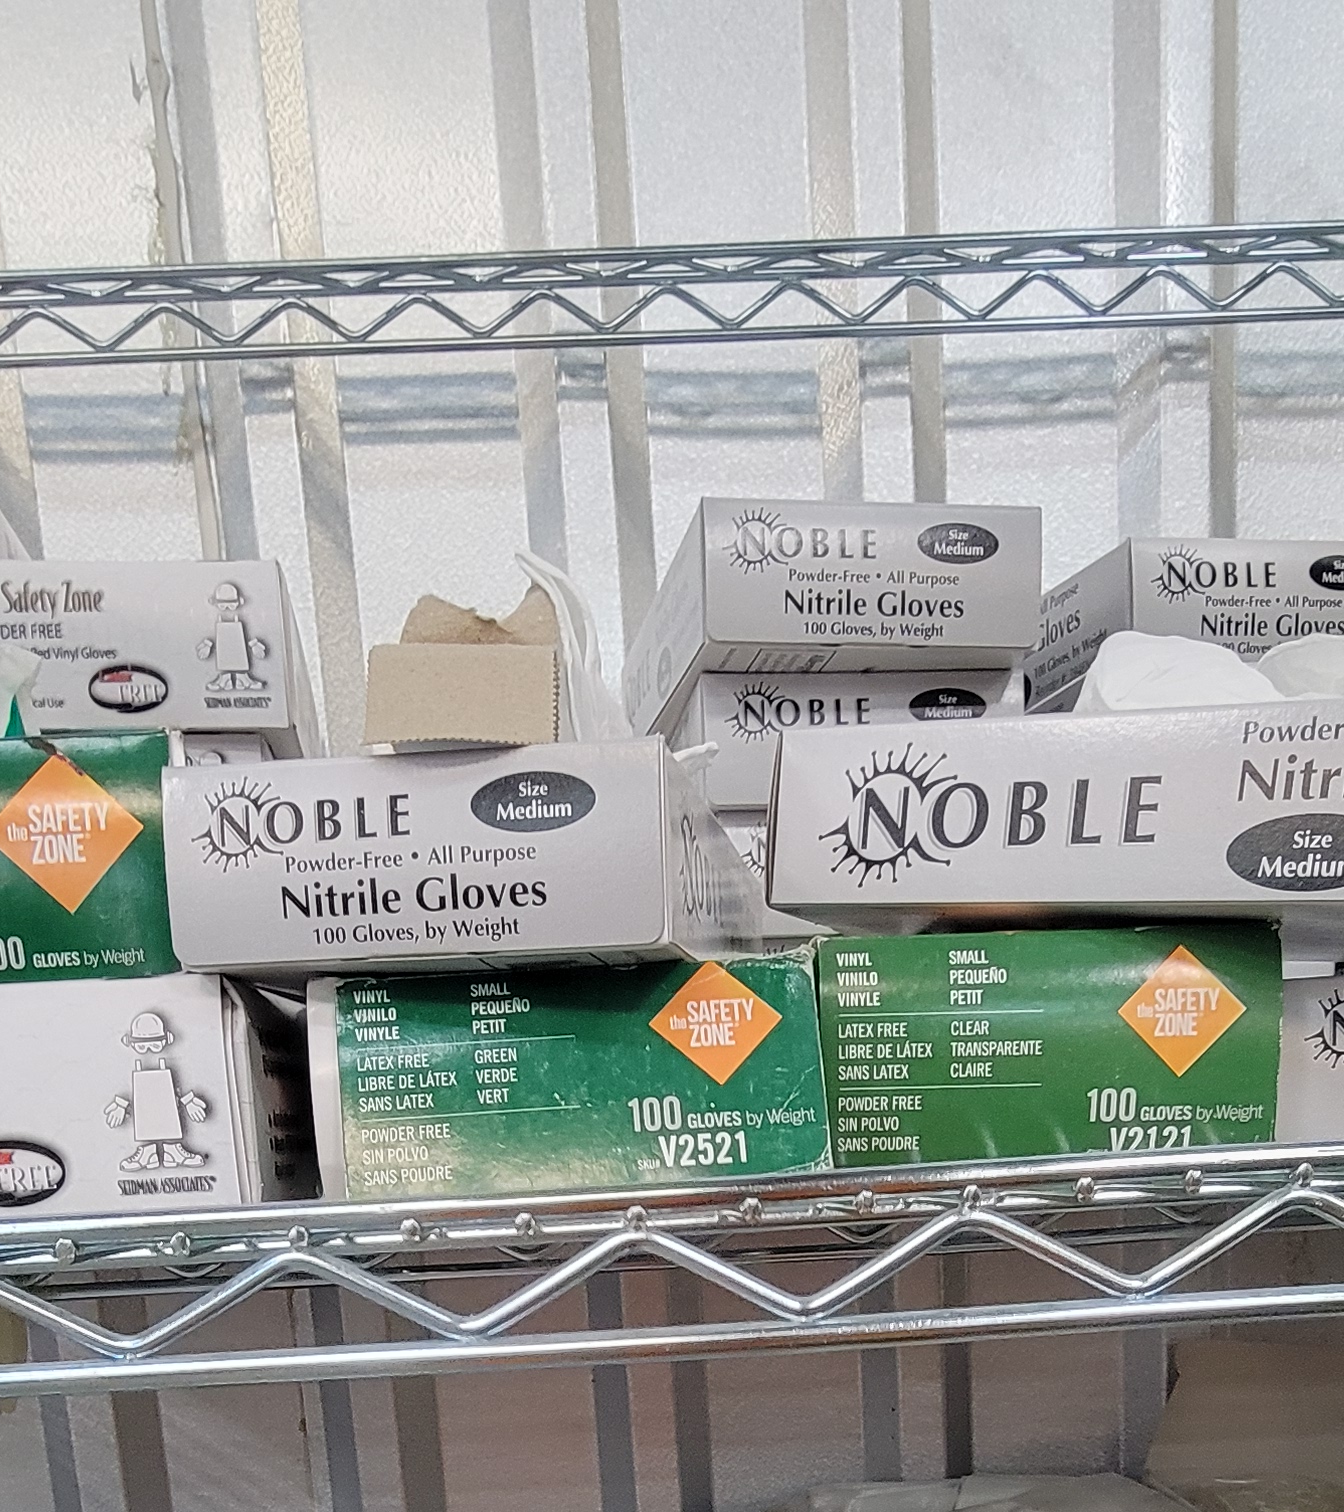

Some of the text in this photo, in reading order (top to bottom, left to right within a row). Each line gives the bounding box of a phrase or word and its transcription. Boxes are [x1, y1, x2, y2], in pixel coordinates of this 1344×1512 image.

[737, 528, 877, 566] NOBLE
[2, 579, 55, 618] Safety
[60, 580, 104, 613] Zone
[784, 590, 964, 620] Nitrile Gloves
[518, 781, 548, 797] Size
[496, 800, 572, 820] Medium
[855, 776, 1162, 865] NOBLE
[7, 802, 108, 842] the SAFETY
[213, 794, 411, 855] NOBLE
[31, 835, 86, 864] ZONE
[1292, 830, 1332, 849] Size
[285, 844, 536, 874] Powder-Free All Purpose
[281, 874, 548, 920] Nitrile Gloves
[312, 919, 520, 944] 100 Gloves, by Weight
[33, 952, 80, 968] GLOVES
[84, 950, 99, 967] by
[101, 947, 145, 966] Weight
[353, 989, 391, 1004] VINYL
[470, 982, 510, 997] SMALL
[471, 997, 530, 1015] PEQUEÑO
[1137, 988, 1219, 1018] the SAFETY
[472, 1019, 506, 1035] PETIT
[951, 1020, 990, 1036] CLEAR
[1155, 1013, 1198, 1036] ZONE
[951, 1040, 1043, 1056] TRANSPARENTE
[950, 1062, 992, 1078] CLAIRE
